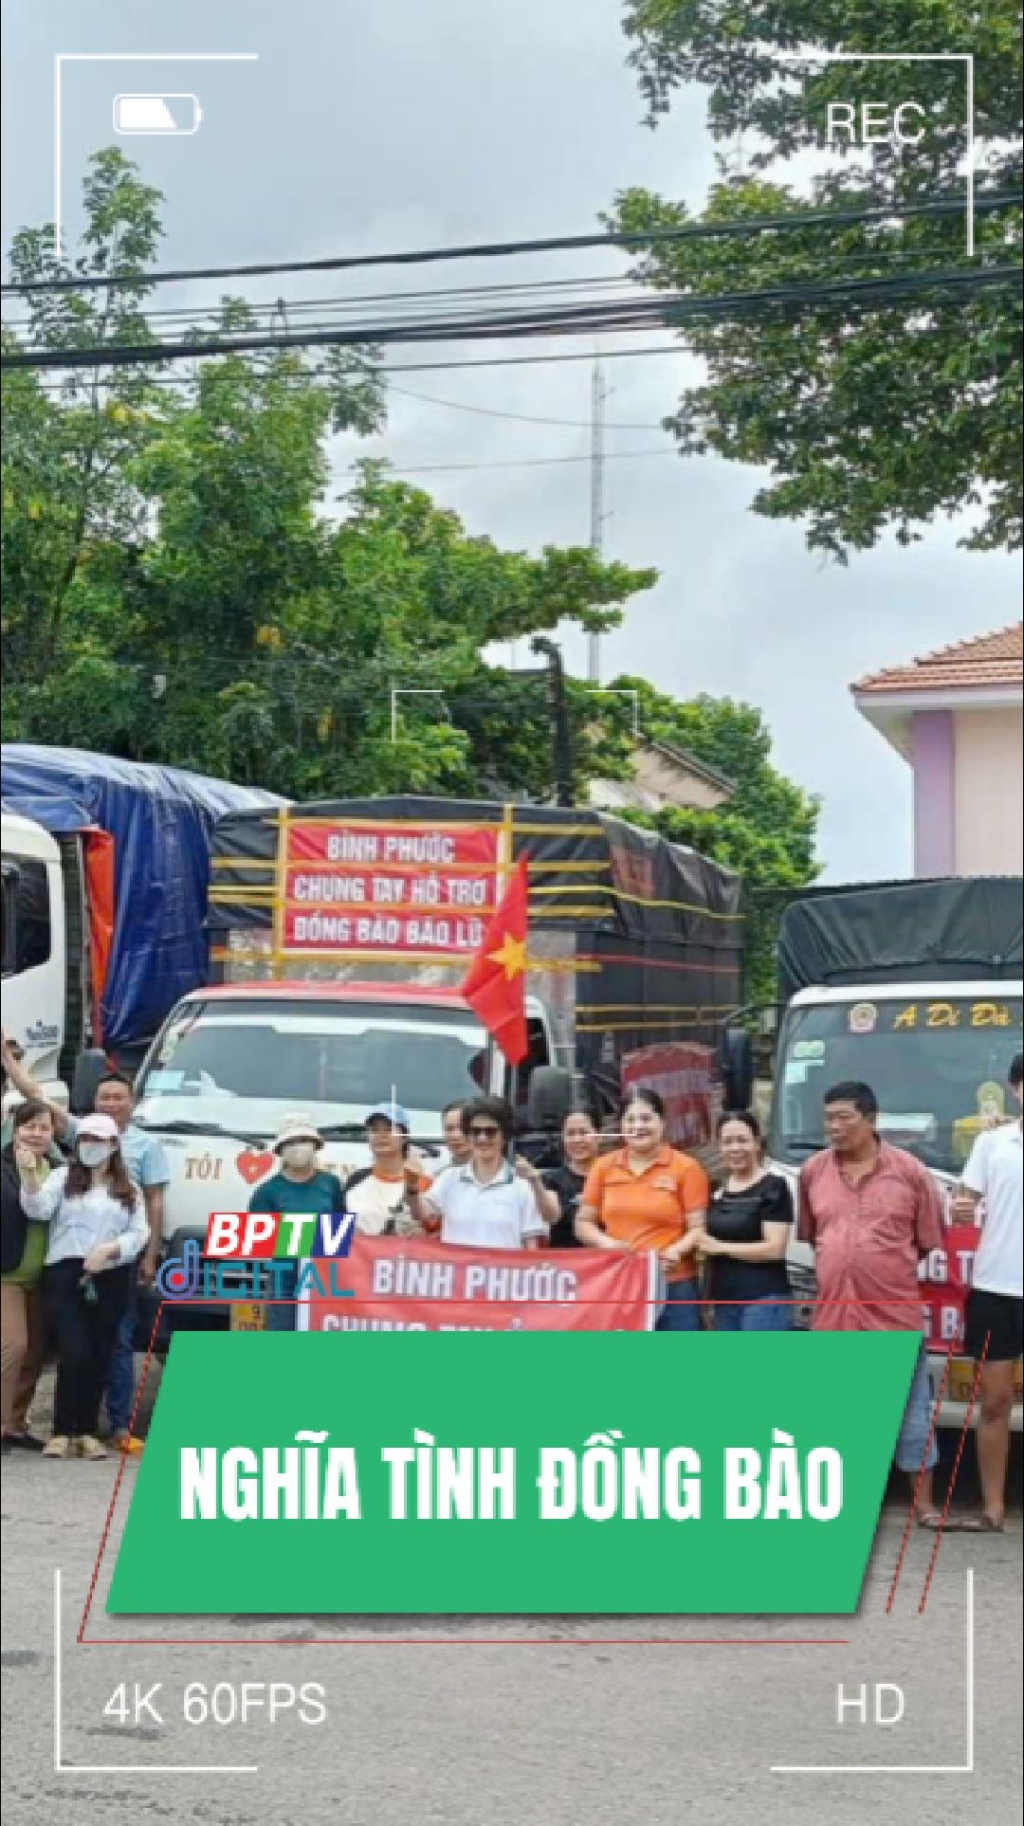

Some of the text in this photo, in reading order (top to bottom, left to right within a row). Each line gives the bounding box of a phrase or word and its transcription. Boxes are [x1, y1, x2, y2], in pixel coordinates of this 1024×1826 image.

[327, 831, 455, 864] BÌNH PHƯỚC
[294, 876, 365, 902] CHUNG
[372, 878, 404, 903] TAY
[373, 1254, 578, 1308] BÌNH PHƯỚC
